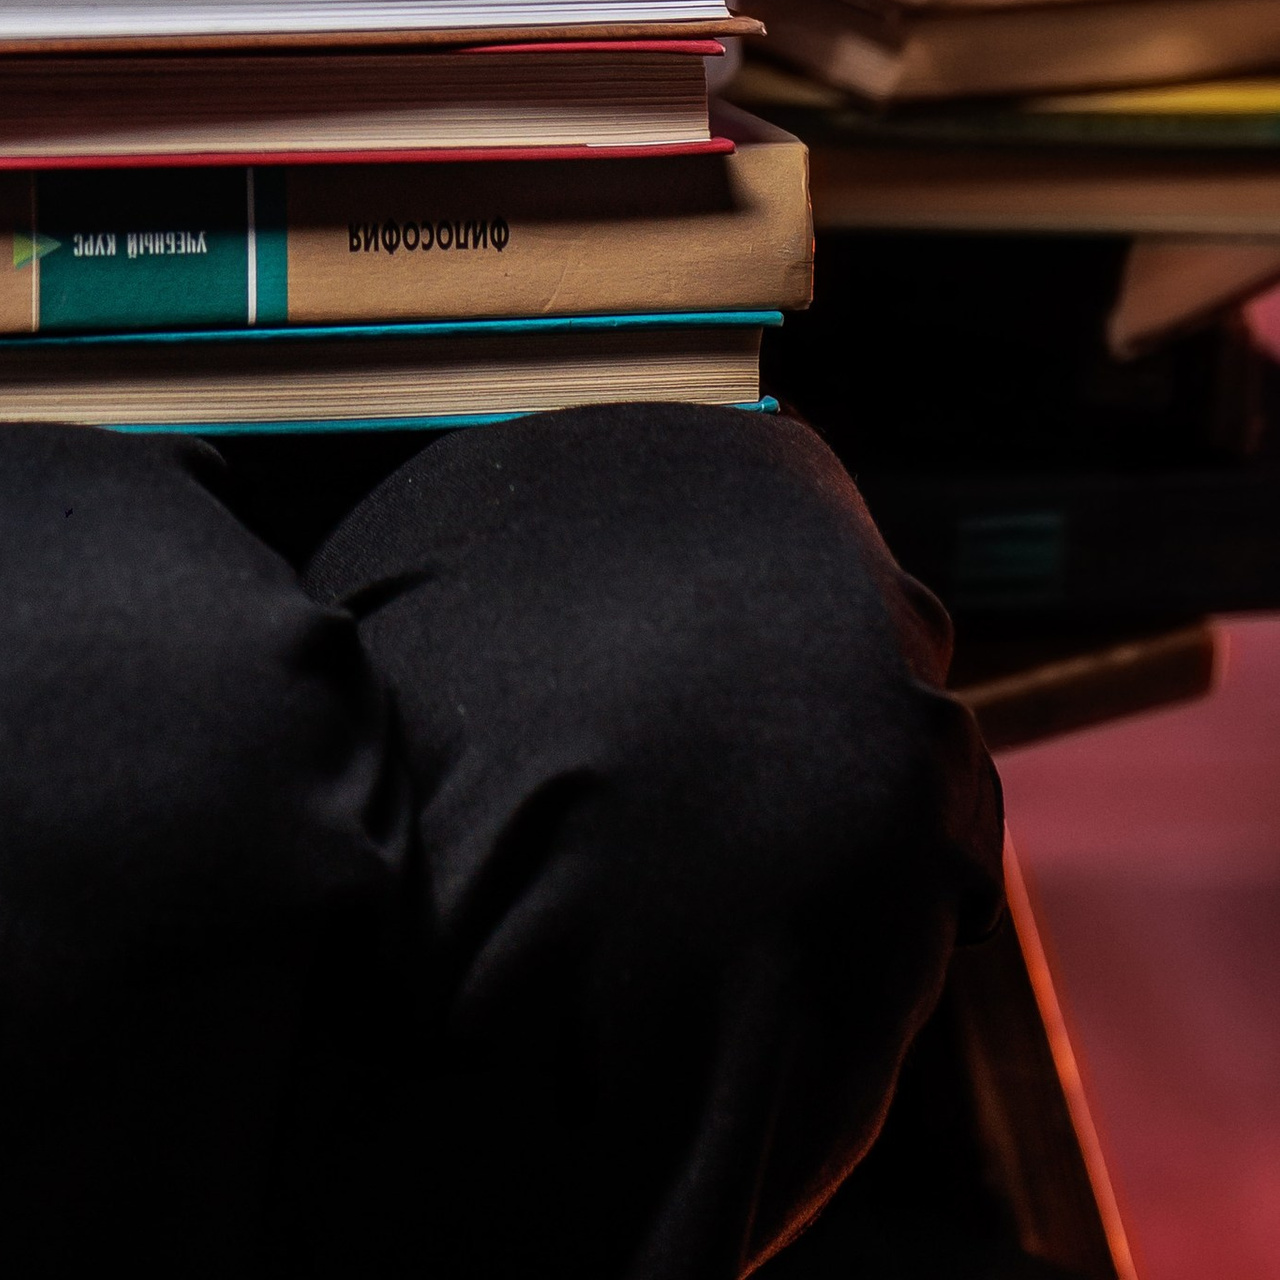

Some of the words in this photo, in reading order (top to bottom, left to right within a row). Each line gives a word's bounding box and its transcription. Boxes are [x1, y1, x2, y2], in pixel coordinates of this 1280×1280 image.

[73, 233, 116, 257] КУРС
[127, 230, 207, 258] УЧЕБНЫЙ
[347, 215, 510, 255] ФИЛОСОФИЯ
